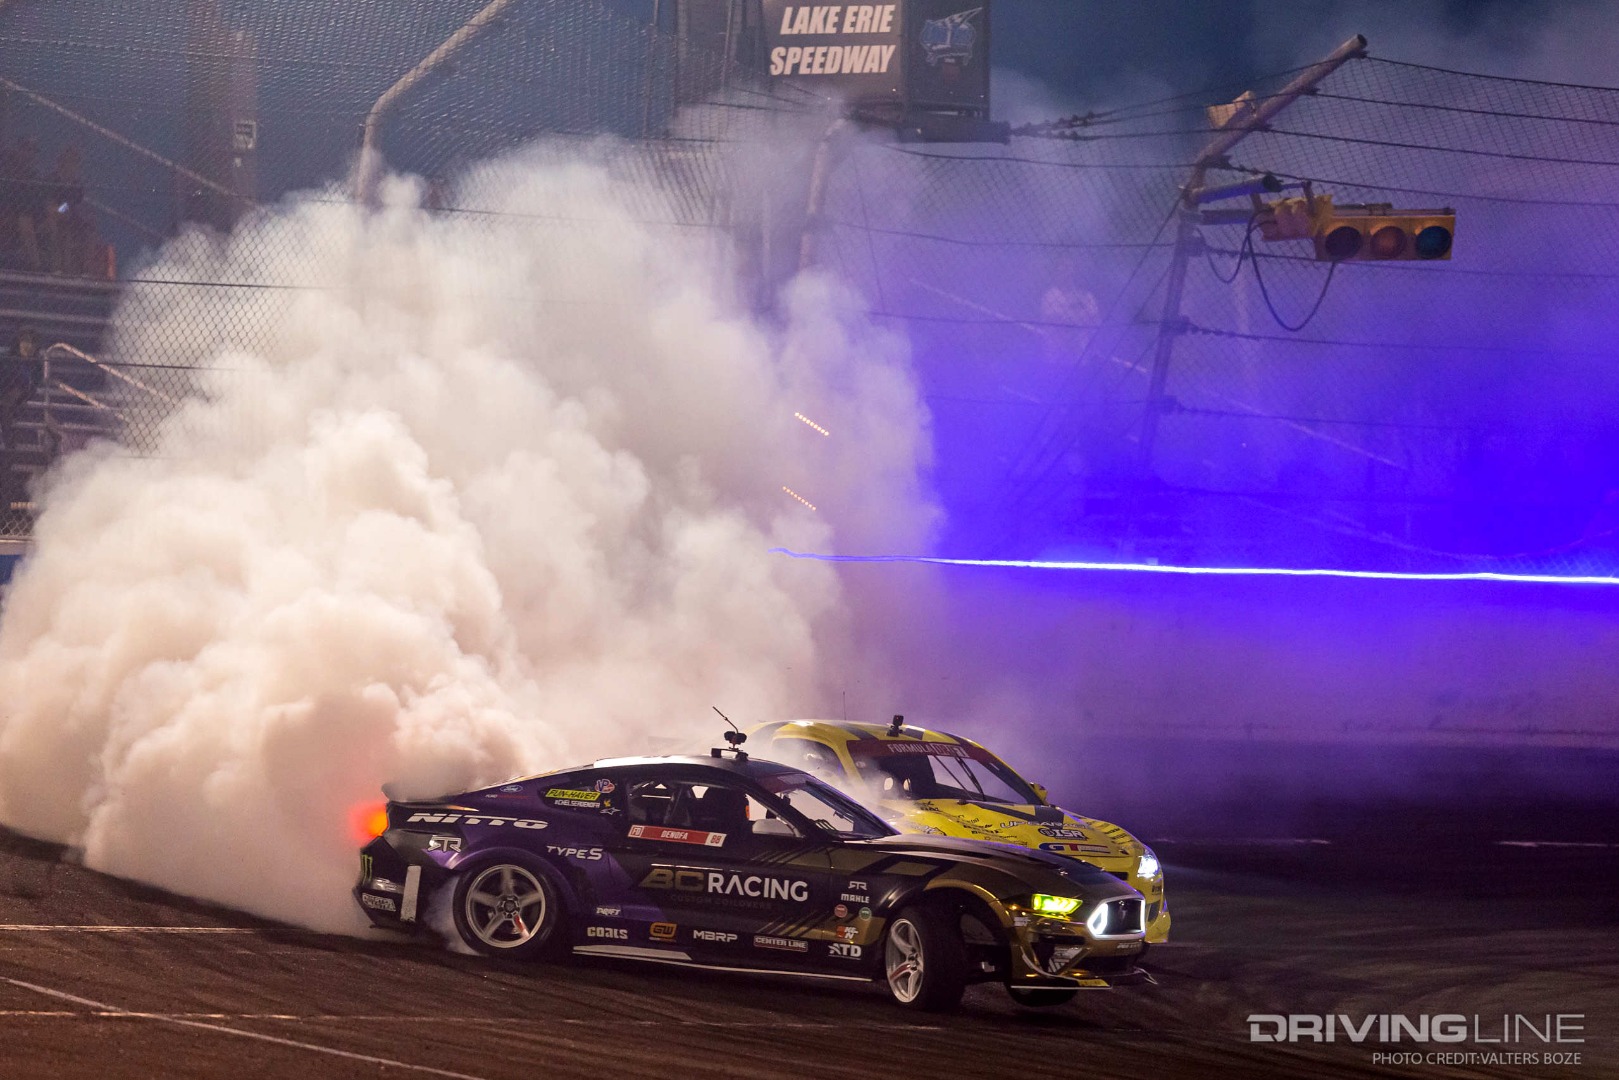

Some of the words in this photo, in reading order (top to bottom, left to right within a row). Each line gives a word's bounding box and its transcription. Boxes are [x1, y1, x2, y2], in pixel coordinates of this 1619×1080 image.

[780, 6, 841, 34] LAKE
[842, 5, 895, 33] ERIE
[770, 45, 896, 75] SPEEDWAY
[887, 743, 935, 753] FORMULA
[548, 788, 599, 799] FUN-HAVER
[407, 812, 549, 830] NITTO
[660, 830, 689, 840] DENOFA
[639, 868, 705, 892] BC
[707, 872, 809, 902] RACING
[841, 893, 870, 903] MAHLE
[693, 930, 738, 942] MBRP
[755, 937, 787, 947] CENTER
[788, 940, 806, 949] LINE
